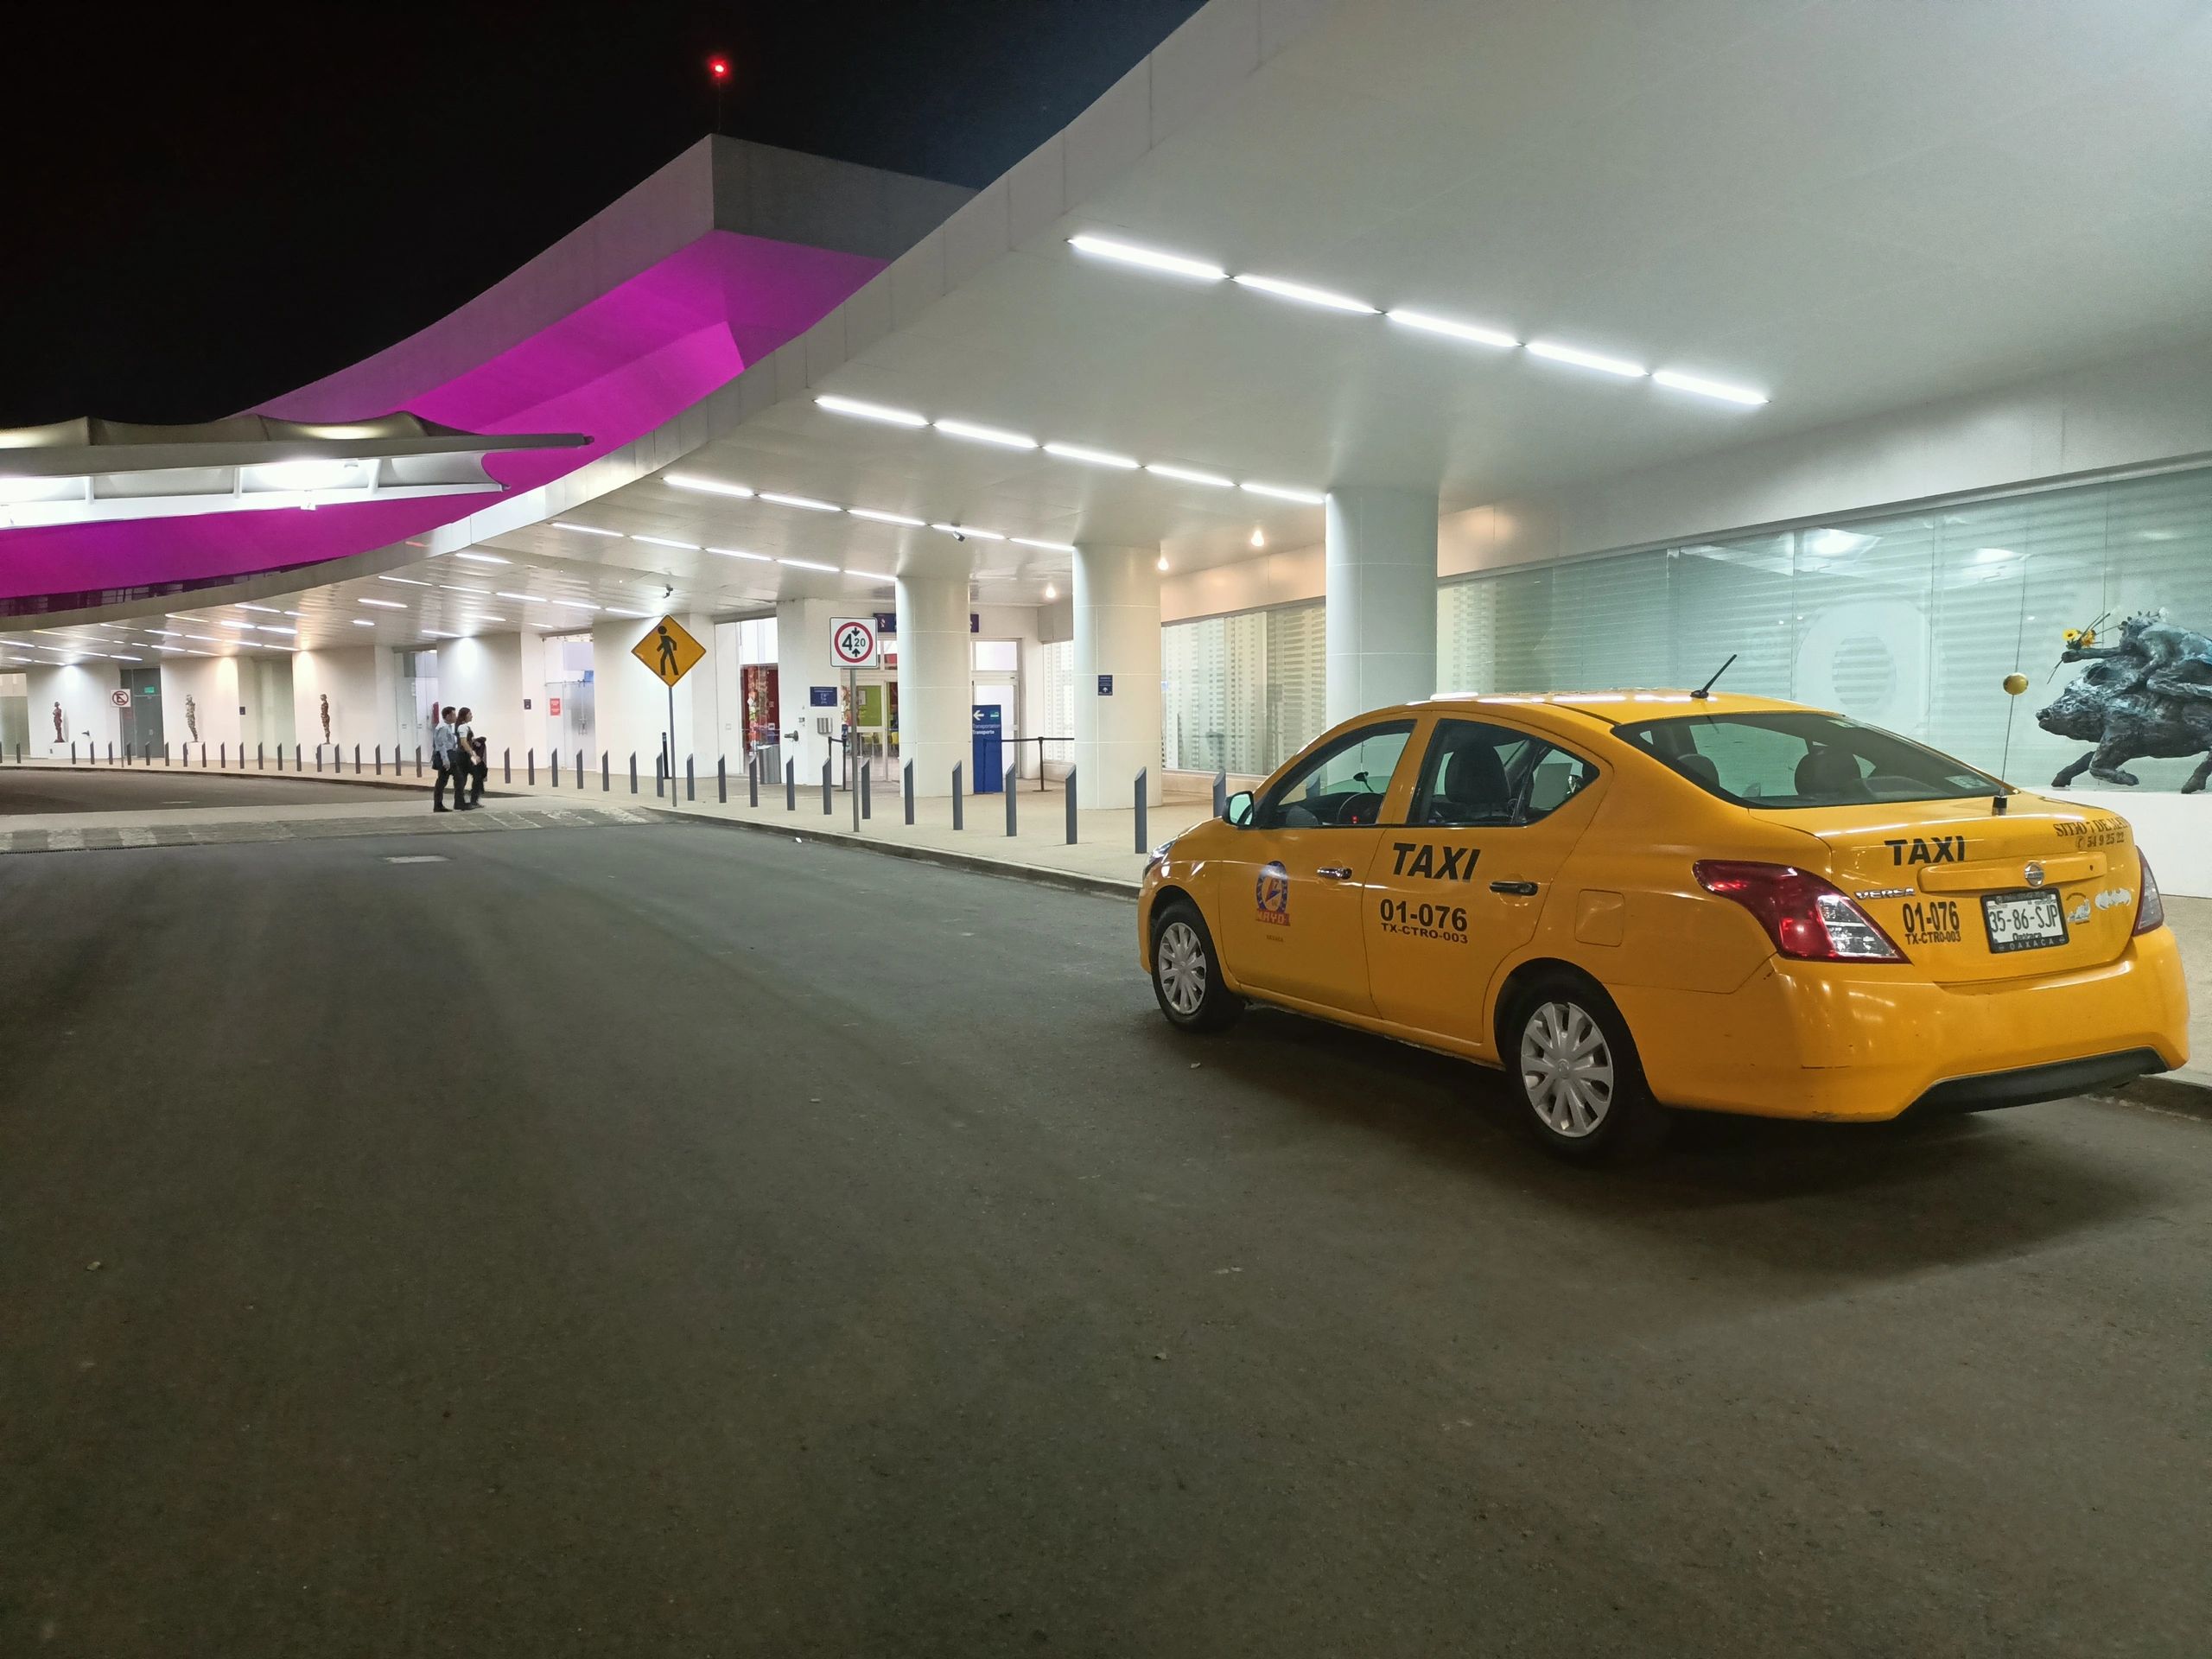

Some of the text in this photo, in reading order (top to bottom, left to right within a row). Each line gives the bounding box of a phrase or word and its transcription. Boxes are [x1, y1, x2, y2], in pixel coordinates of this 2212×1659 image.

[842, 633, 866, 651] 4 20
[2052, 822, 2088, 837] SITIO
[1392, 842, 1481, 882] TAXI
[1884, 836, 1965, 866] TAXI
[1380, 899, 1468, 932] 01-076
[1902, 901, 1960, 933] 01-076
[1988, 904, 2058, 932] 35-86-SJP
[1381, 922, 1469, 944] TX-CTRO-003
[1904, 930, 1961, 945] TX-CTRO-003
[2009, 938, 2055, 950] OAXACA
